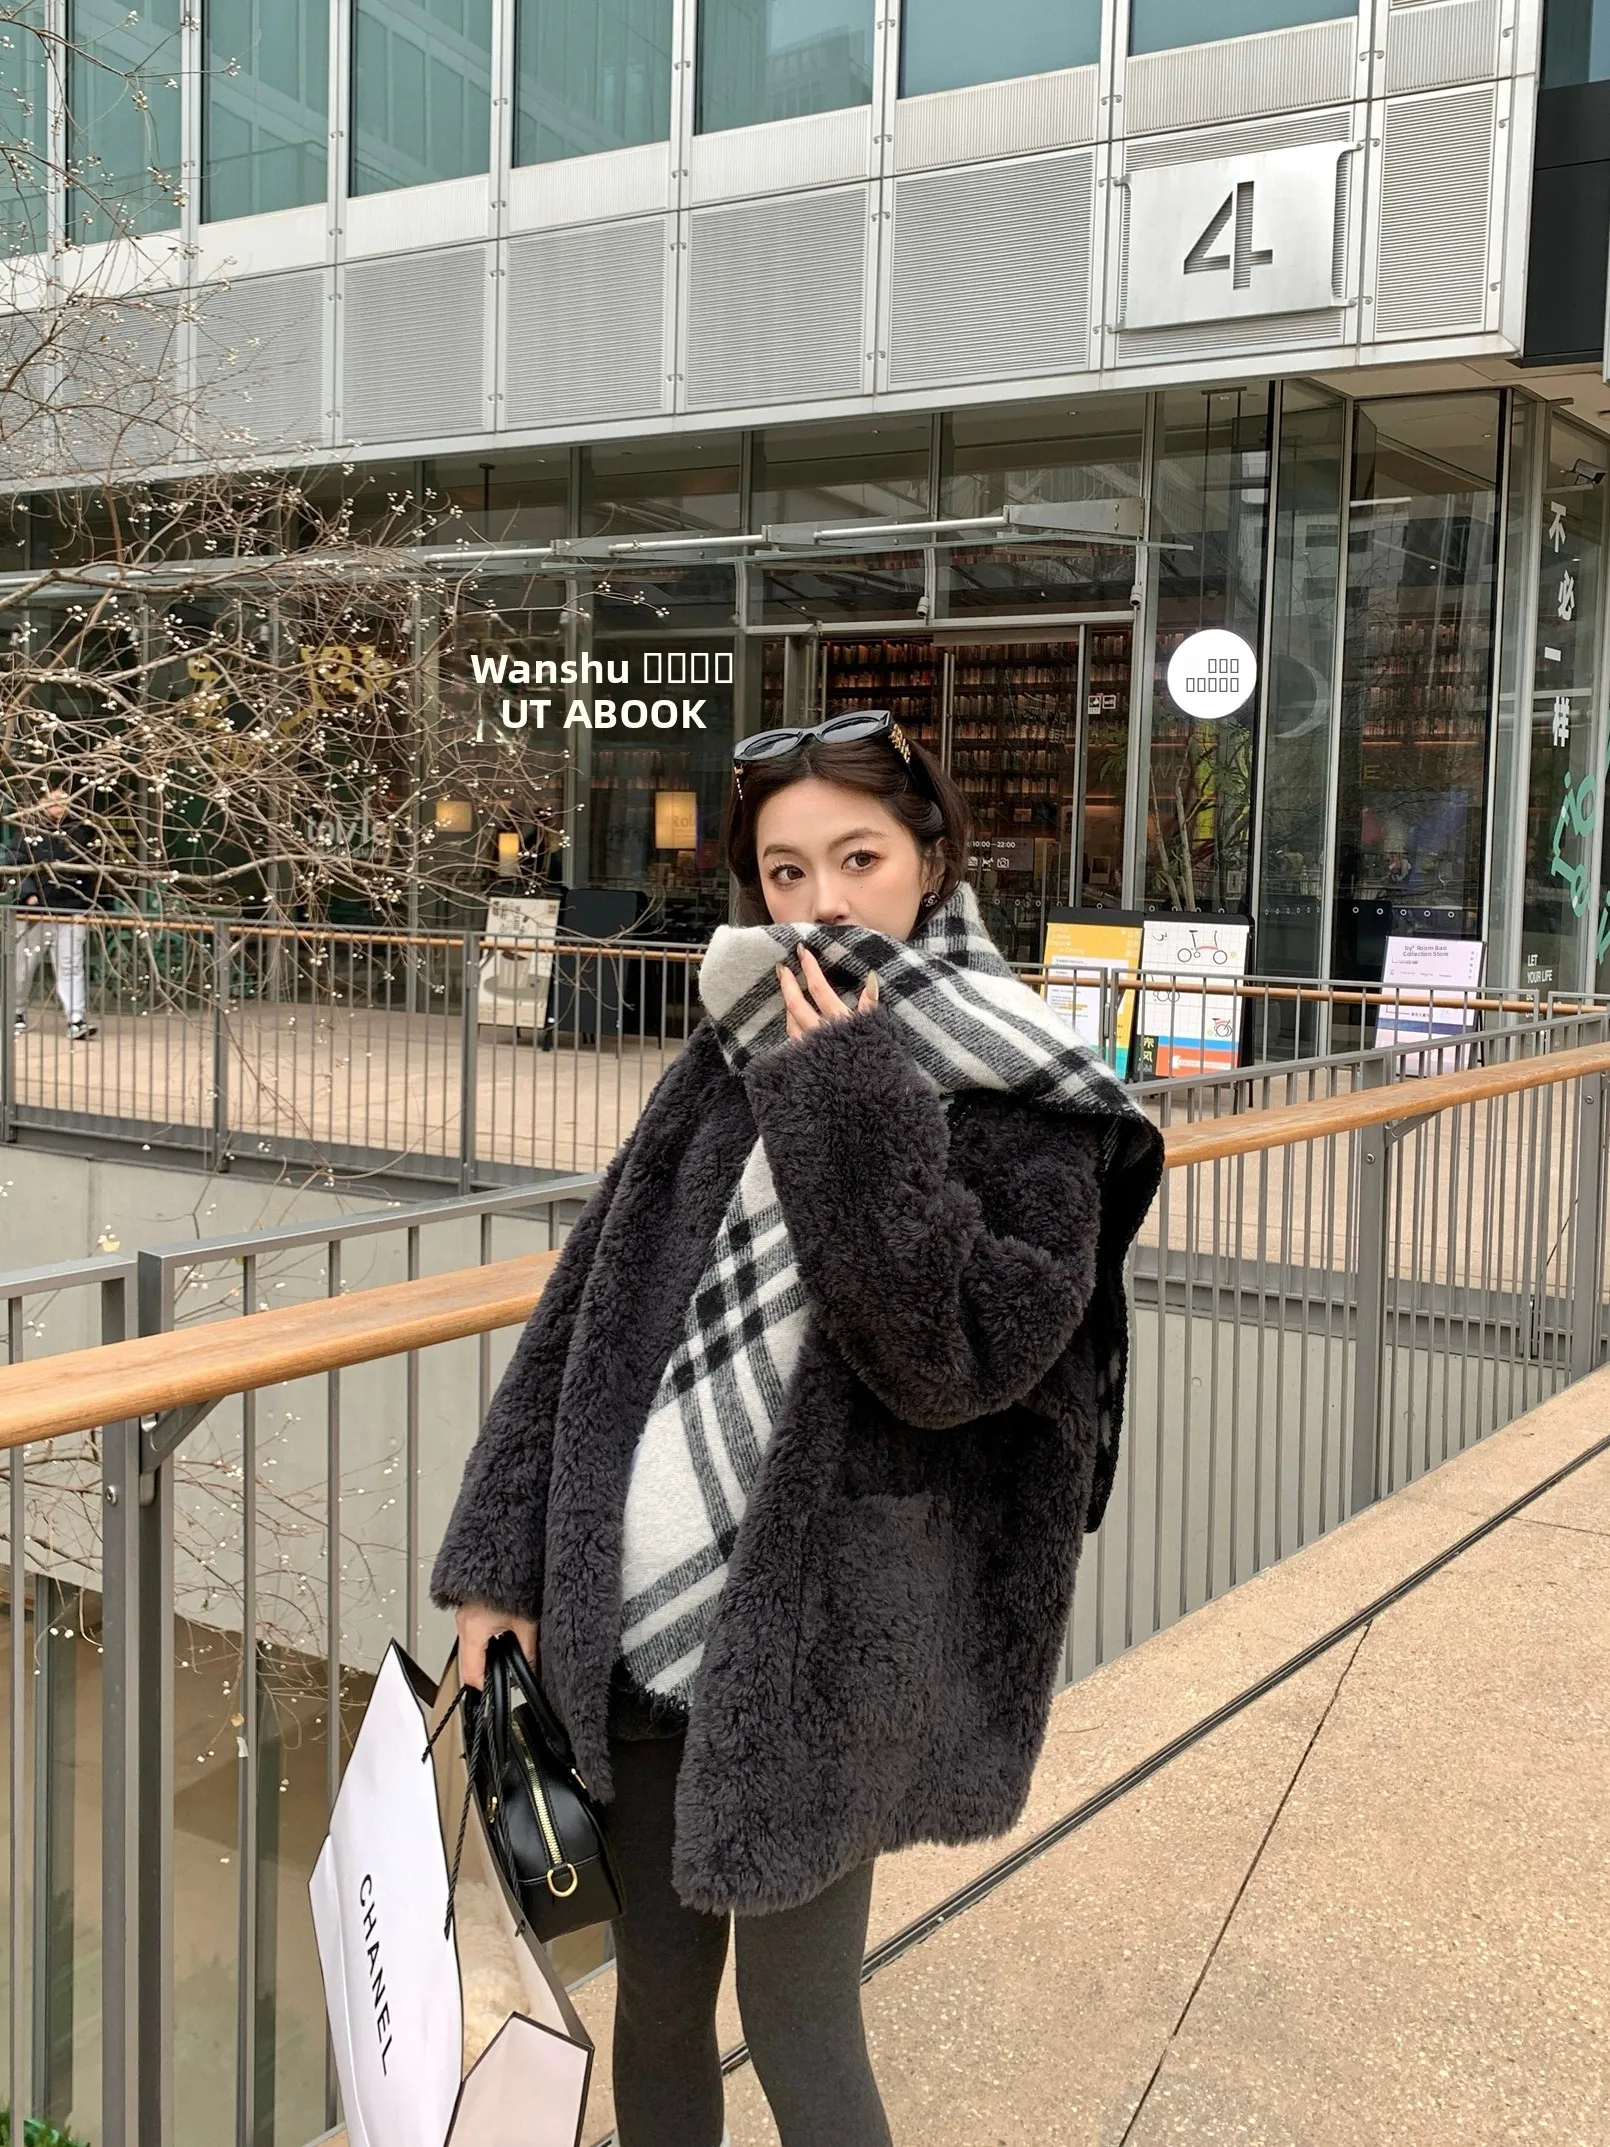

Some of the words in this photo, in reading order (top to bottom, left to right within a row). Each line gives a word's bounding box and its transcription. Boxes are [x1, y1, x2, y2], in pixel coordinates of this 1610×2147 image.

[1183, 181, 1273, 290] 4
[470, 652, 629, 684] Wanshu
[502, 699, 551, 729] UT
[563, 699, 707, 729] ABOOK
[1527, 954, 1538, 967] LET
[1527, 971, 1541, 984] YOUR
[1542, 969, 1553, 982] LIFE
[359, 1874, 394, 2076] CHANEL
